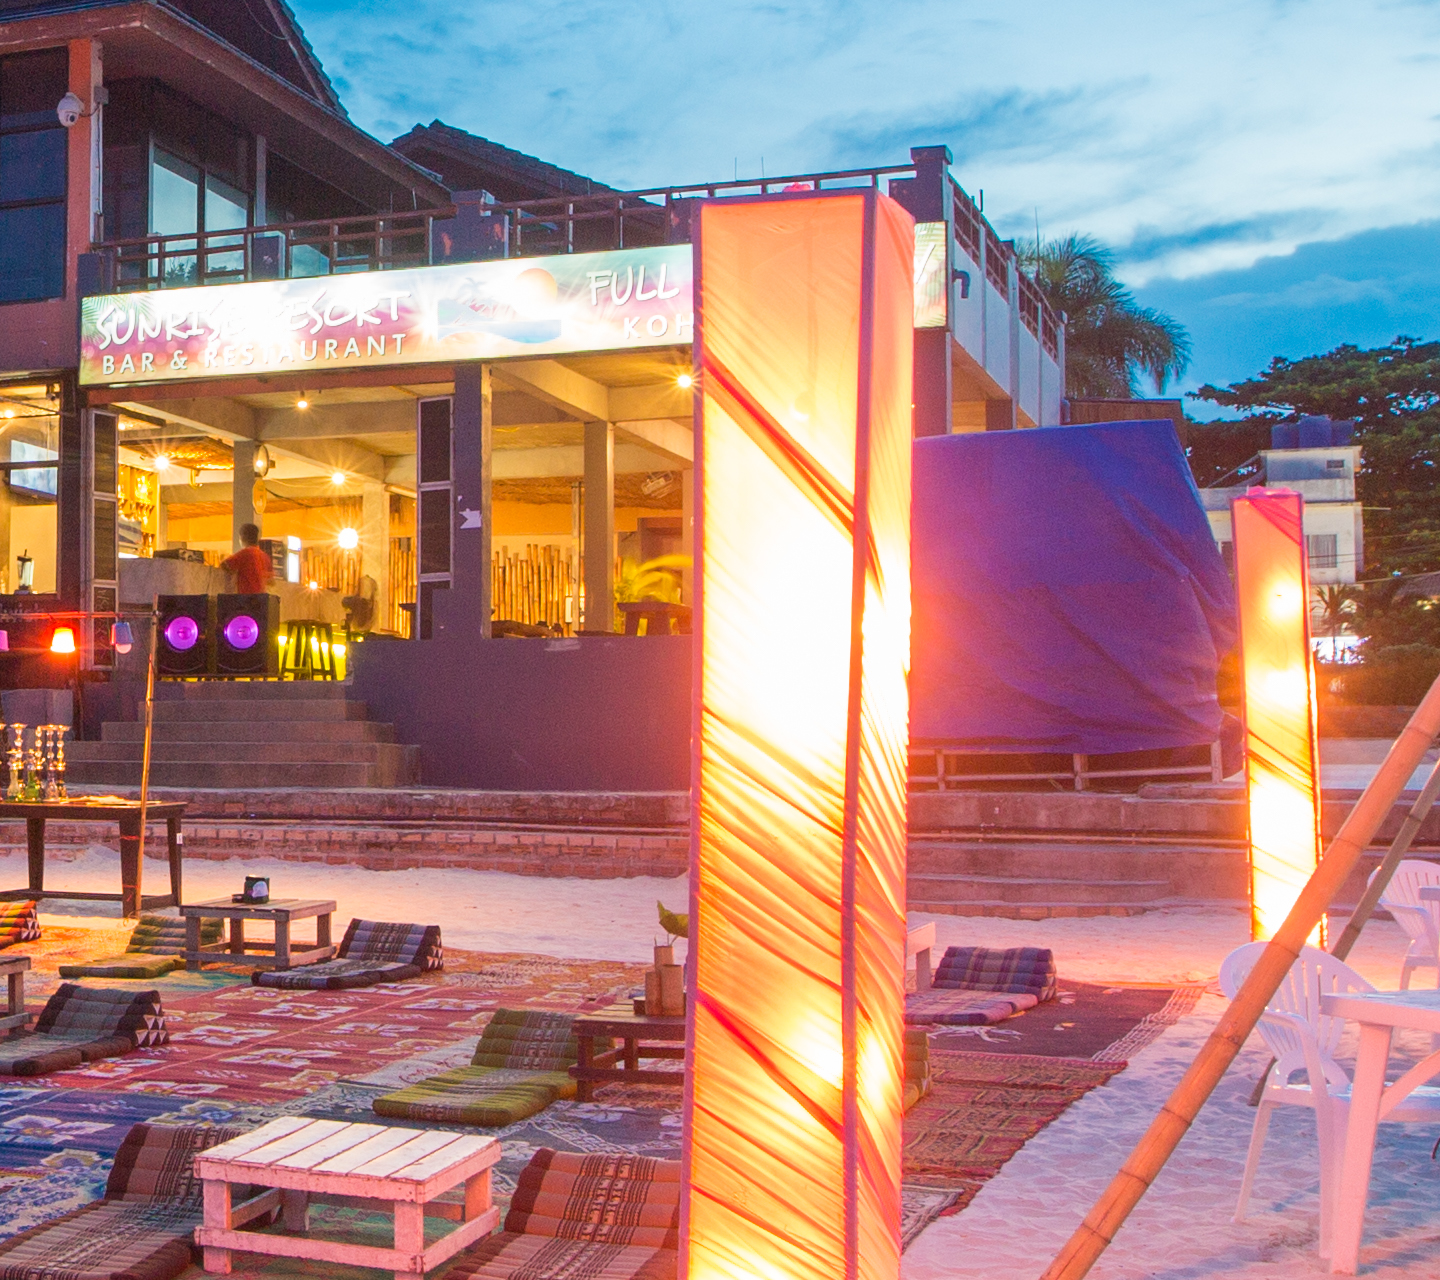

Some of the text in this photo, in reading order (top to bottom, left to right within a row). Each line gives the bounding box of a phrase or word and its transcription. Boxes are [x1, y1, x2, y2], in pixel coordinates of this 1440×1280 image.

[586, 263, 680, 306] FULL
[95, 286, 413, 350] SUNRIS ESORT
[623, 312, 694, 340] KOH
[102, 333, 407, 376] BAR & RESTAURANT
